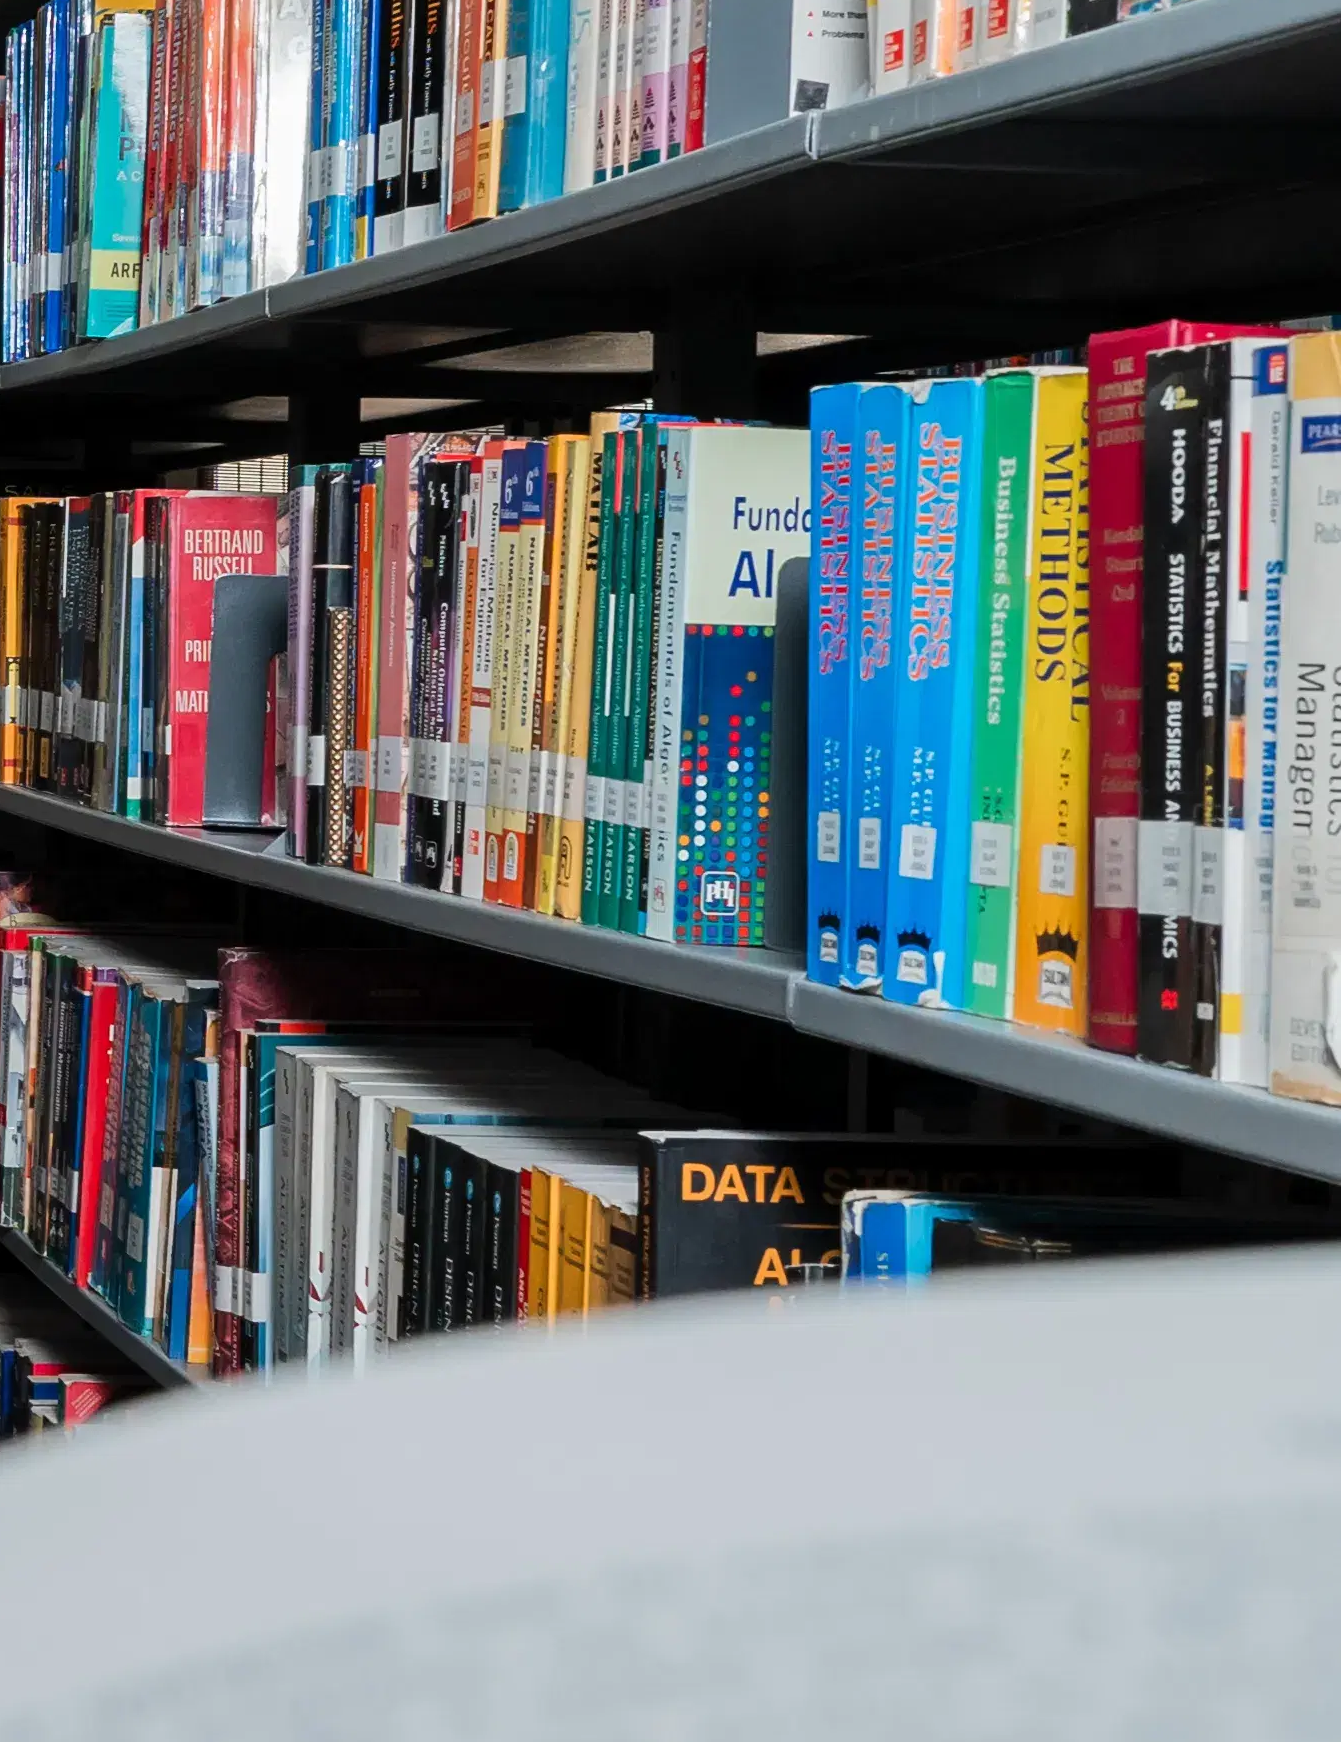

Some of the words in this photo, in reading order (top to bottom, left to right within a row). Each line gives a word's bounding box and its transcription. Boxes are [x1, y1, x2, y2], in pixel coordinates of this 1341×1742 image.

[994, 456, 1018, 587] Business
[1170, 427, 1187, 524] HOODA
[1203, 418, 1223, 542] Financial
[185, 529, 264, 554] BERTRAND
[489, 502, 500, 594] Numerical
[505, 543, 515, 639] NUMERICAL
[526, 536, 537, 635] NUMERICAL
[819, 430, 837, 675] STATISTICS
[834, 442, 853, 662] BUSINESS
[860, 429, 880, 682] STATISTICS
[876, 442, 896, 668] BUSINESS
[907, 422, 941, 682] STATISTICS
[930, 433, 962, 669] BUSINESS
[1035, 443, 1076, 683] METHODS
[1166, 553, 1186, 654] STATISTICS
[436, 602, 448, 658] Computer
[484, 597, 494, 673] Methods
[665, 530, 682, 689] Fundamentals
[986, 592, 1011, 726] Statistics
[1202, 551, 1222, 719] Mathematics
[1263, 560, 1284, 689] Statistics
[500, 650, 509, 732] METHODS
[520, 645, 530, 727] METHODS
[1165, 701, 1182, 793] BUSINESS
[681, 1162, 805, 1204] DATA
